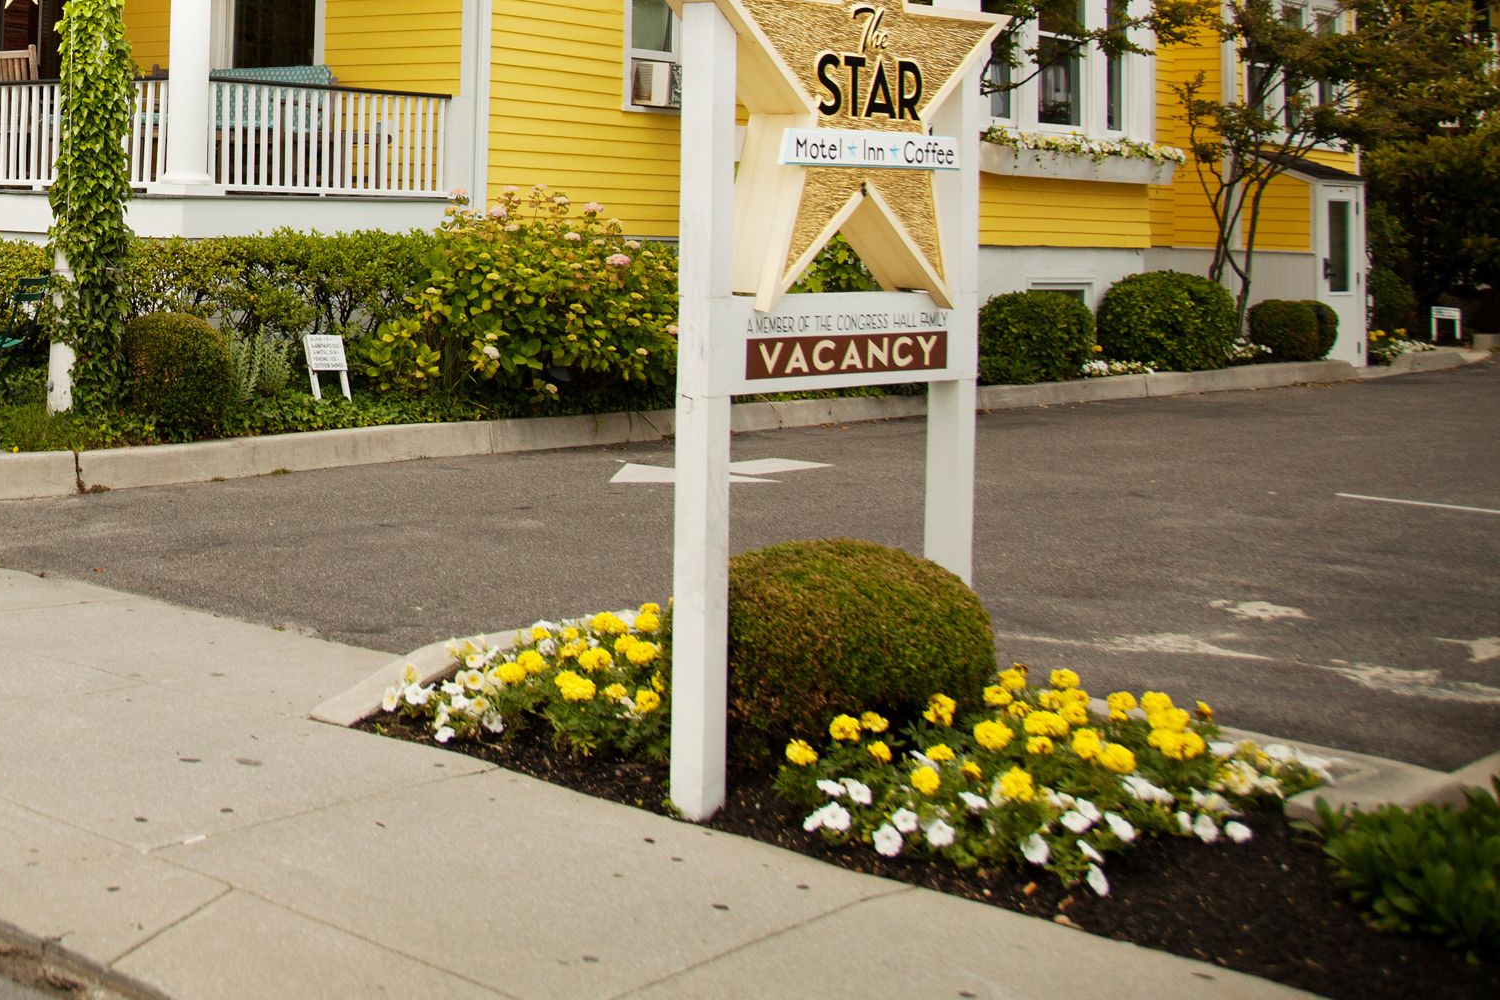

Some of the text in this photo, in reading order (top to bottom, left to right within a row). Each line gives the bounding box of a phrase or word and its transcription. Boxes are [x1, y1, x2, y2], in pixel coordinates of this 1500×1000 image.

[852, 6, 889, 53] The
[816, 53, 923, 121] STAR
[795, 137, 954, 165] Motel Inn Coffee
[747, 311, 949, 334] A MEMBER OF THE CONGRESS HALL FAMILY
[757, 335, 940, 376] VACANCY
